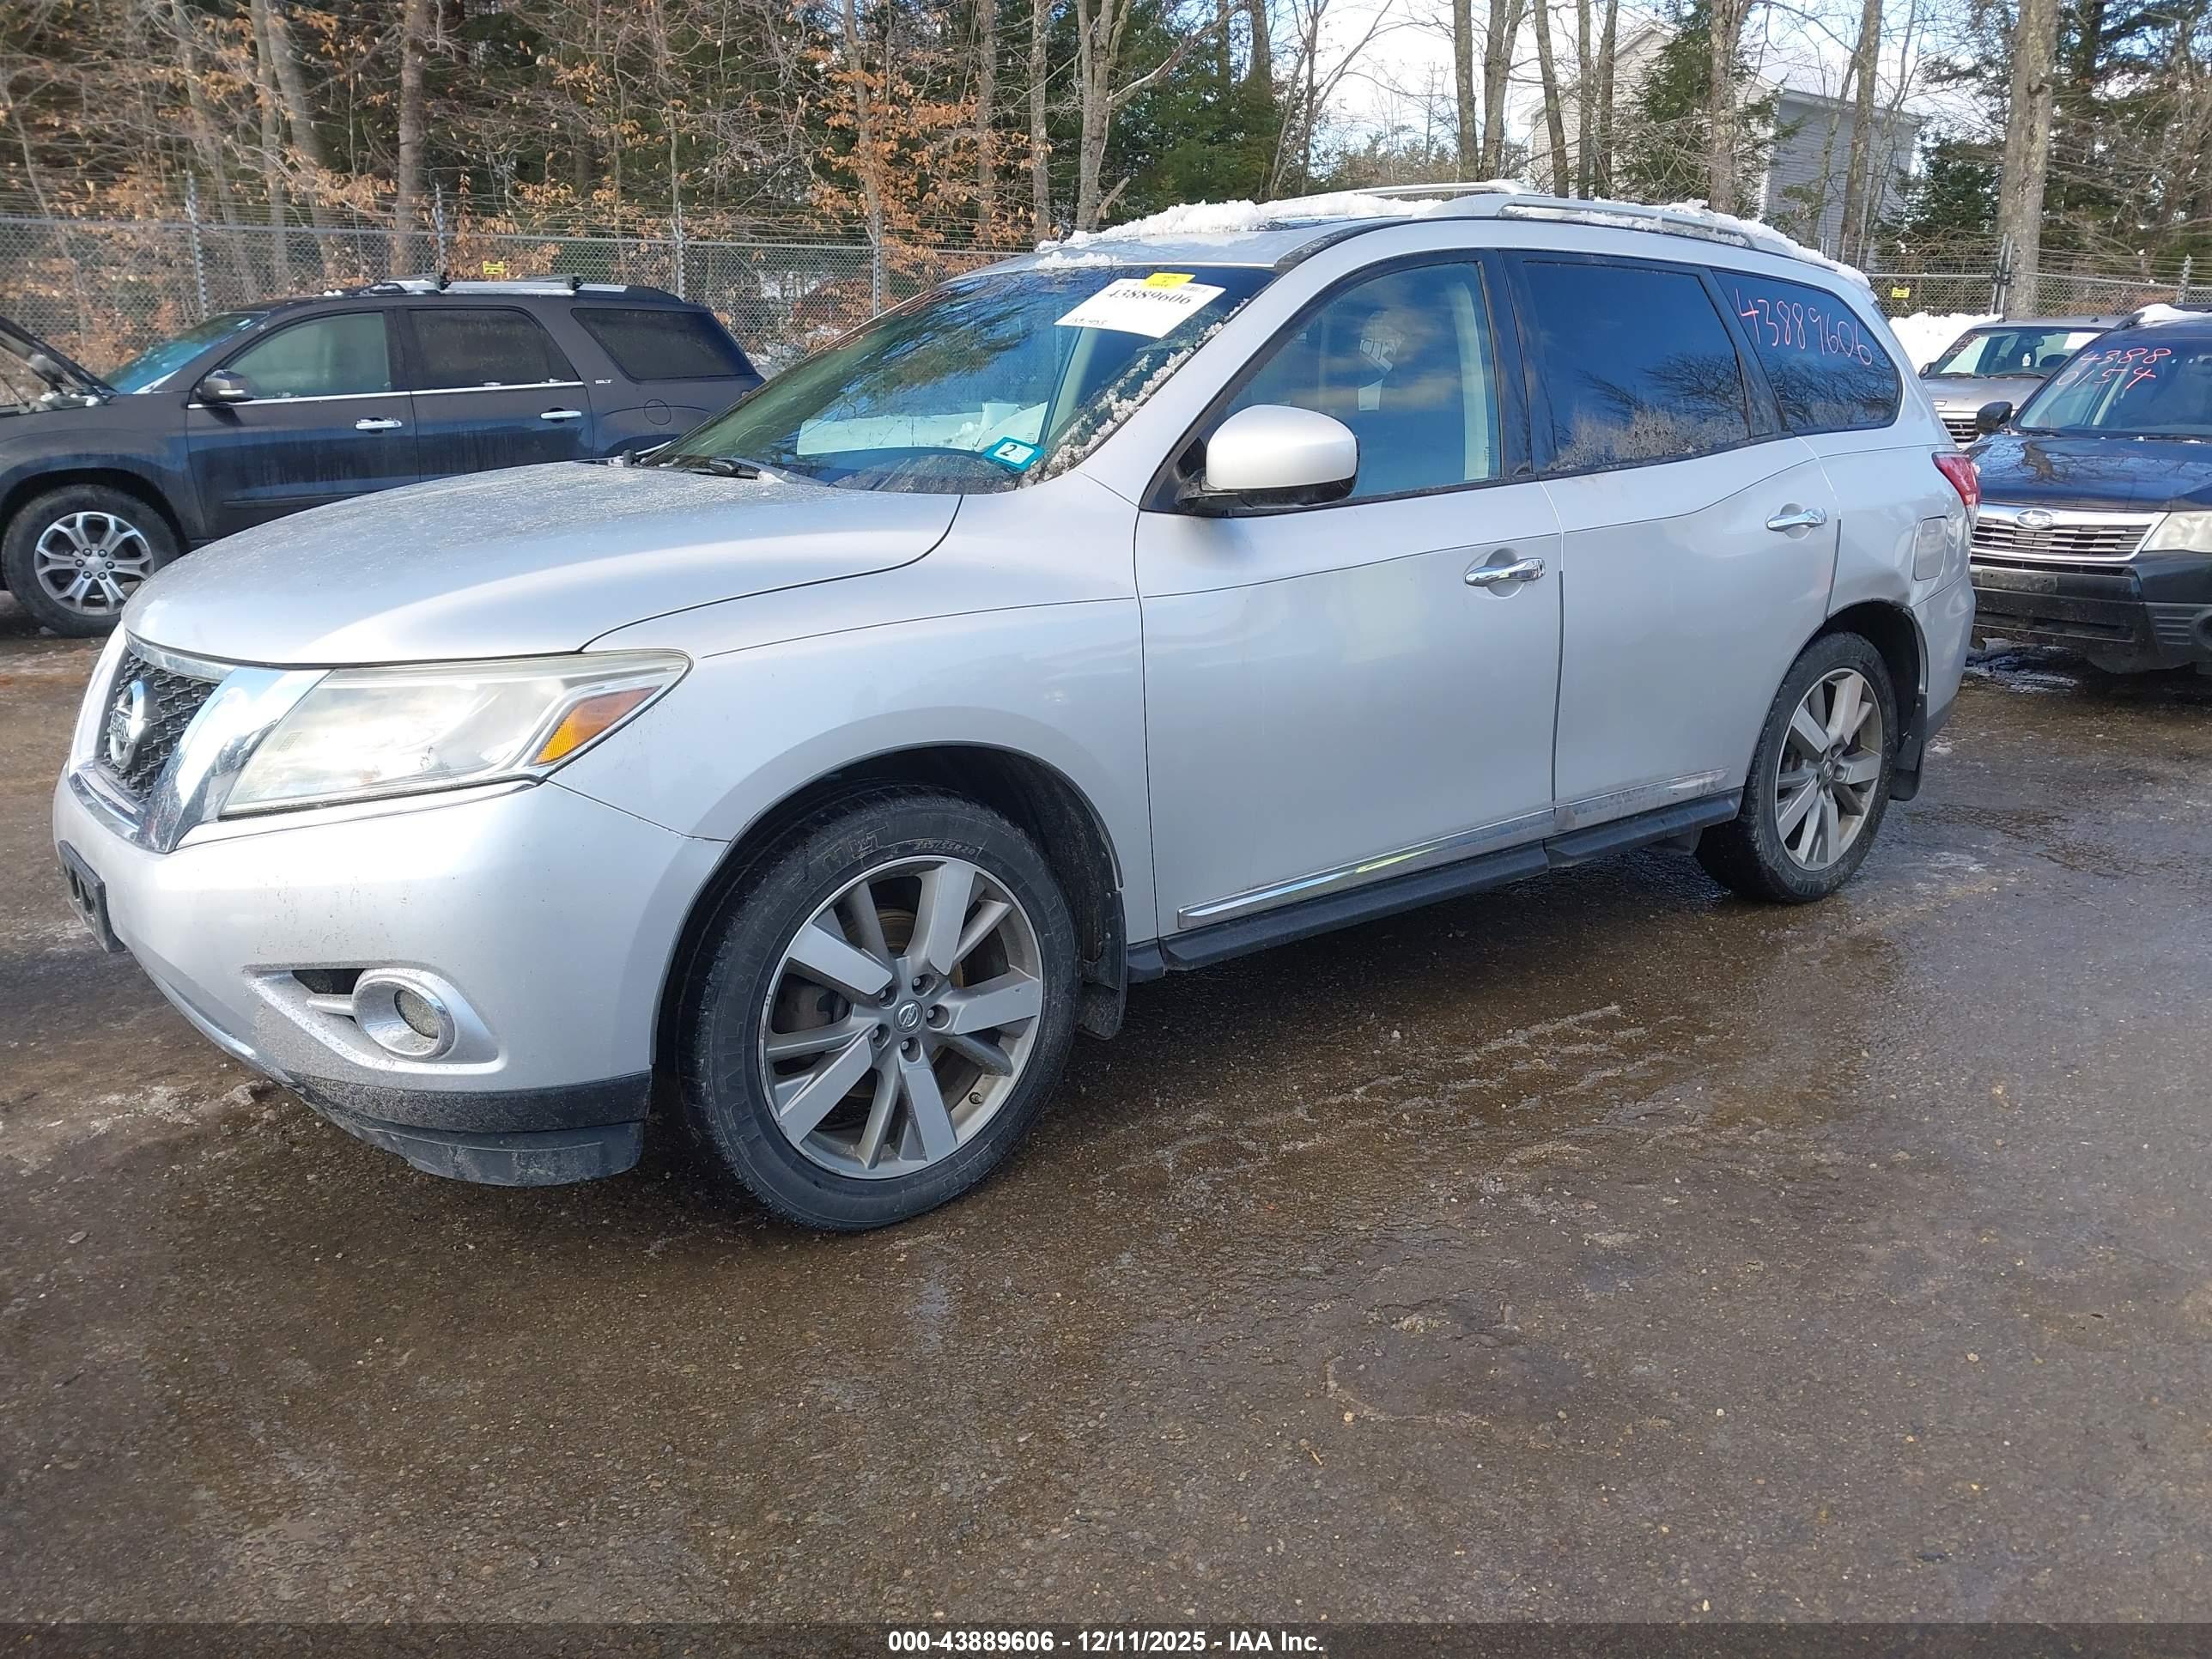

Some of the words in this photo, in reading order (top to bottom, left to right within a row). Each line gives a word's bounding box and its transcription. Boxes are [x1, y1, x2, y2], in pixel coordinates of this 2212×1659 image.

[1735, 288, 1873, 366] 43889606
[2079, 347, 2172, 366] 4388
[1000, 444, 1018, 457] 2
